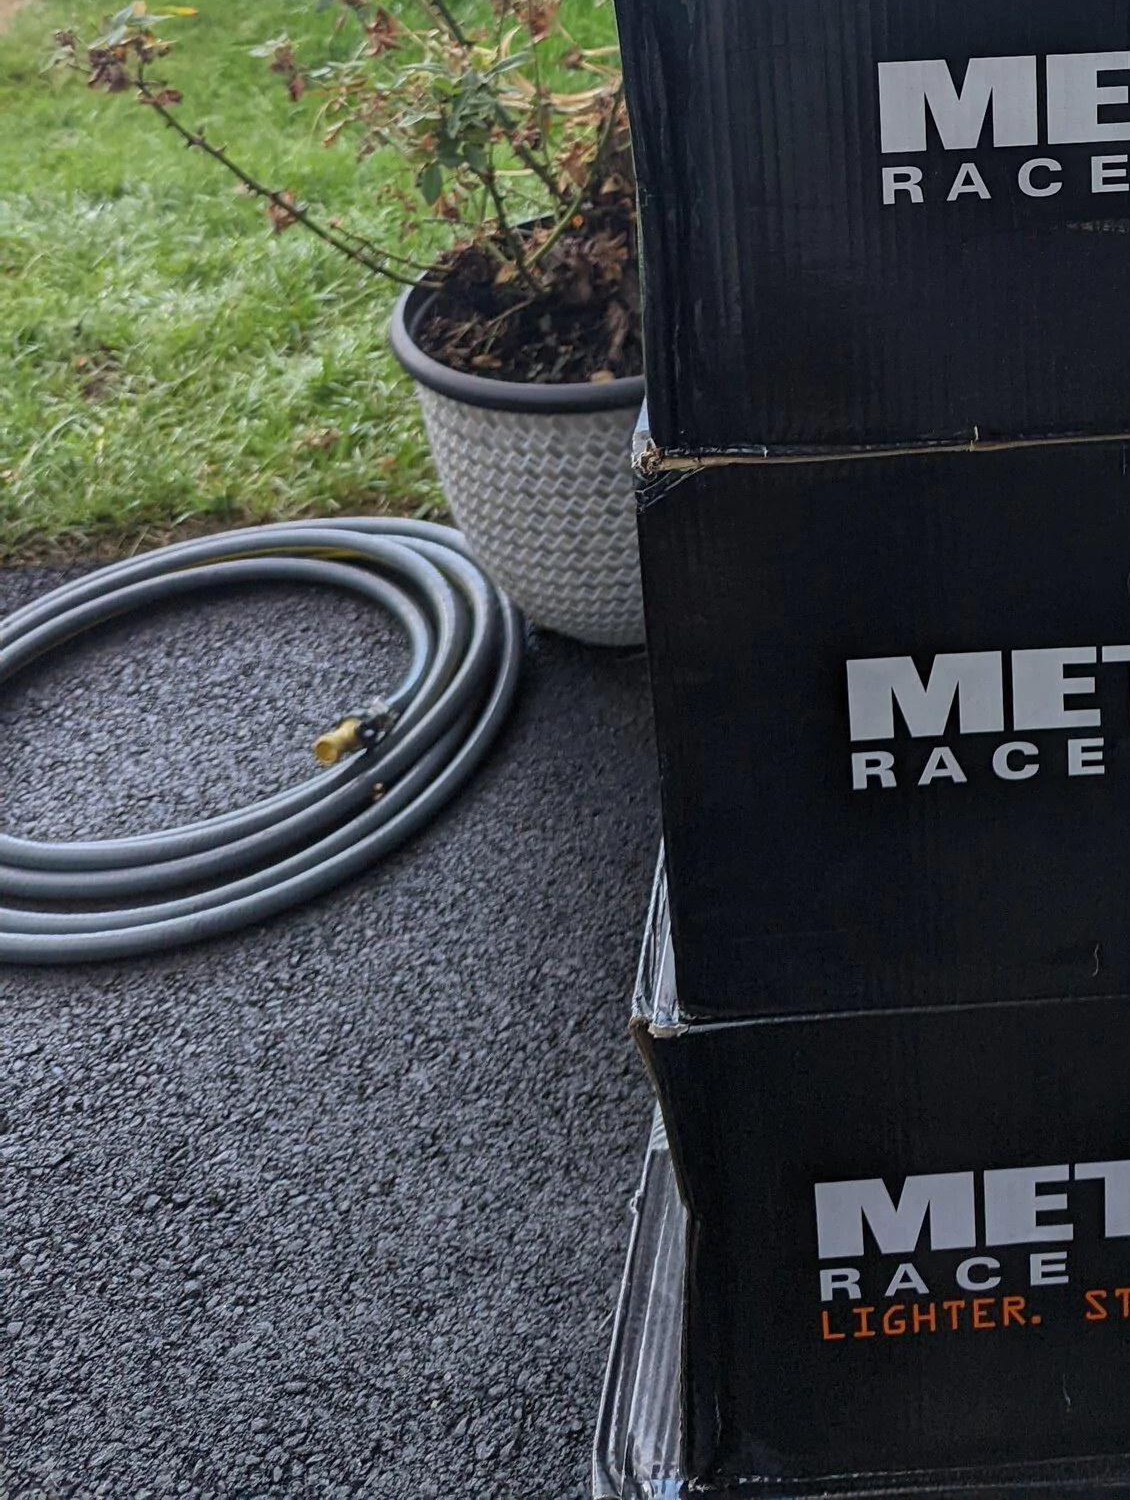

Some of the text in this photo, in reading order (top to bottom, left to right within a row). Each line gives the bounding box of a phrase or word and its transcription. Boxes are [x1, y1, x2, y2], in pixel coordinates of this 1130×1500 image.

[881, 153, 1130, 206] RACE
[851, 736, 1106, 790] RACE
[819, 1252, 1070, 1302] RACE
[820, 1294, 1044, 1341] LIGHTER.
